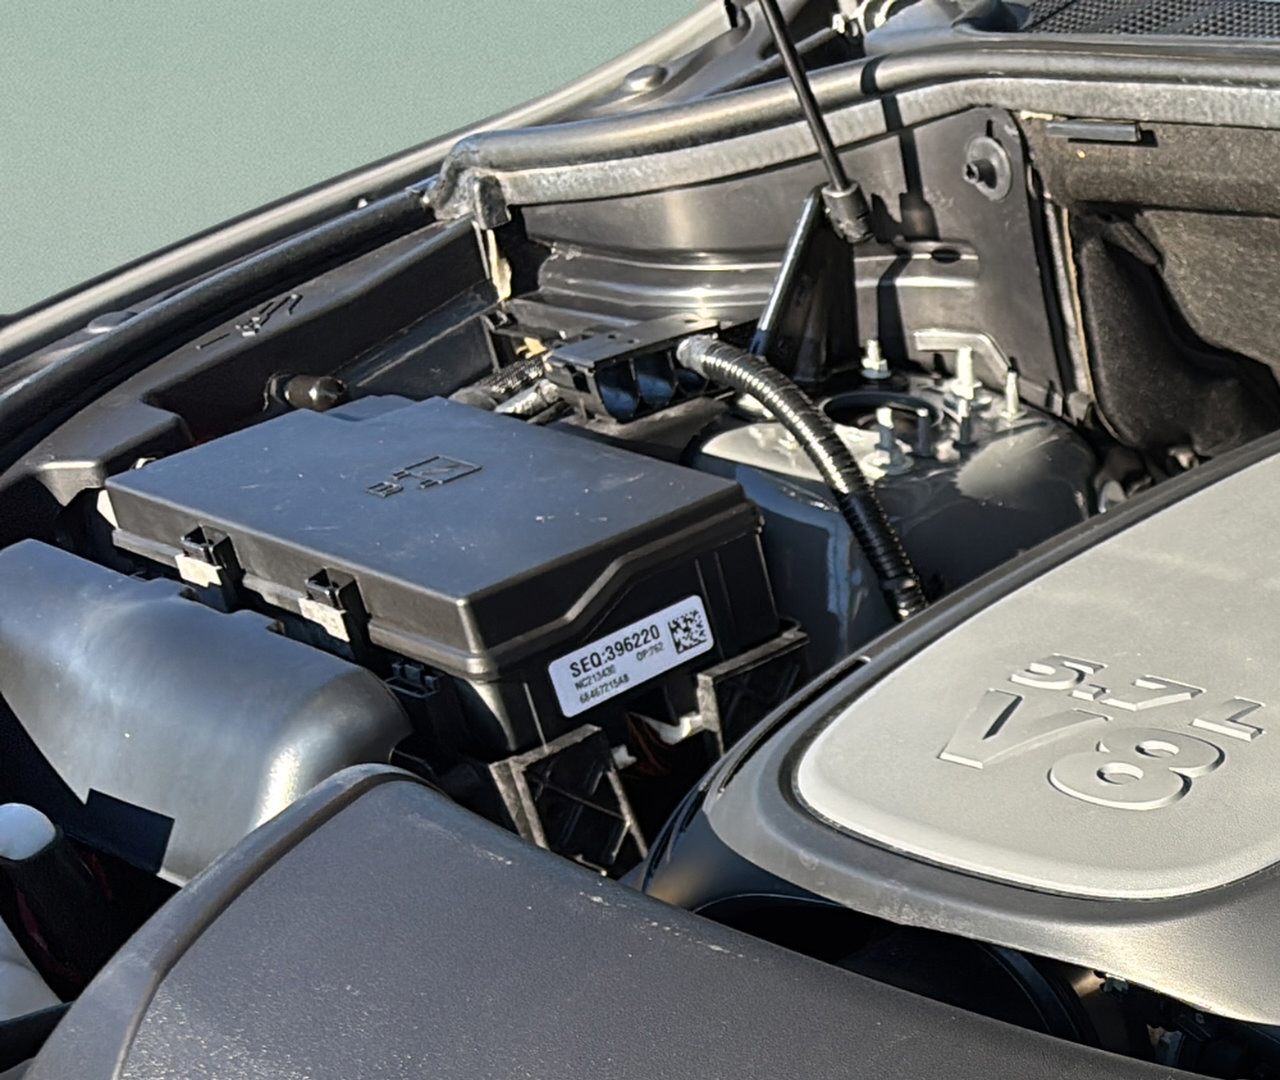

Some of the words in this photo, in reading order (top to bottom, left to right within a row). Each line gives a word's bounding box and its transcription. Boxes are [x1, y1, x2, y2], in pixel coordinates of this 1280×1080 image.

[569, 624, 660, 679] SEQ:396220
[1009, 653, 1266, 742] 5.7L
[937, 688, 1226, 811] V8
